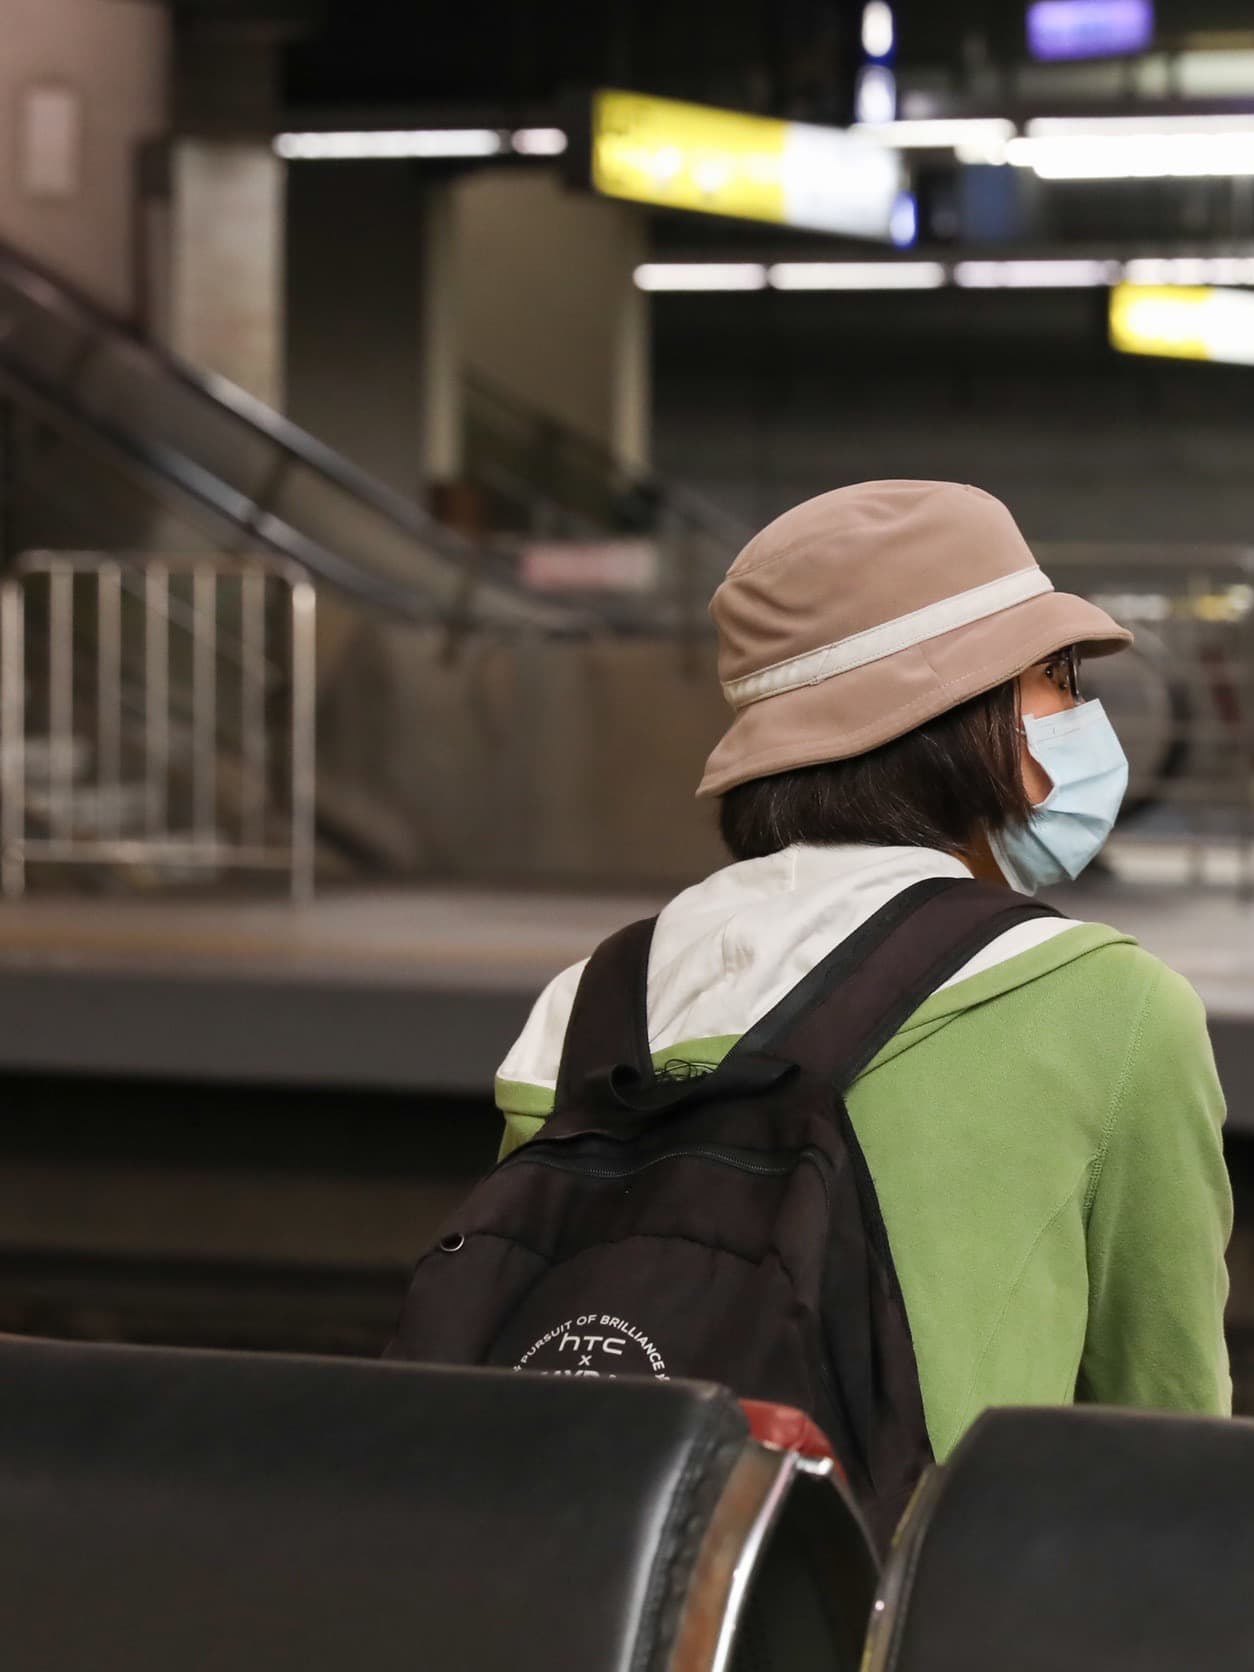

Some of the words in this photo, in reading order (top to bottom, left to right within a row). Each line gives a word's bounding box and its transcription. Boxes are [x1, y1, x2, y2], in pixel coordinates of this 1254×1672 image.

[520, 1320, 573, 1364] PURSUIT
[576, 1314, 598, 1326] OF
[600, 1314, 665, 1372] BRILLIANCE
